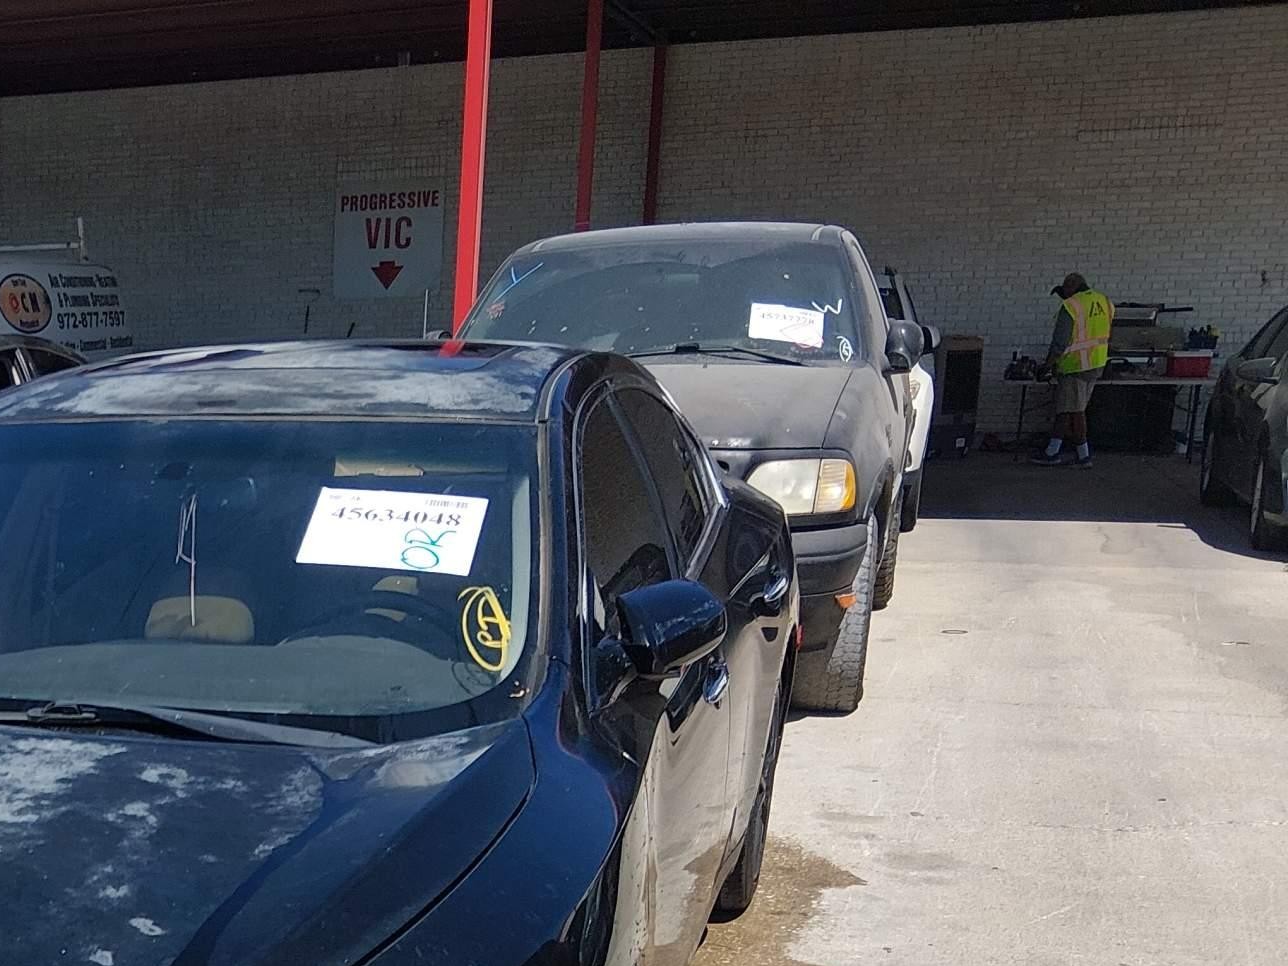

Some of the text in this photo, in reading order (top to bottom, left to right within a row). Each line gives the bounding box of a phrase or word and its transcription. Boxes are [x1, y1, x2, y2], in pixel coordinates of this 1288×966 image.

[341, 190, 440, 213] PROGRESSIVE
[365, 216, 413, 249] VIC
[57, 311, 125, 330] 972-877-7597
[330, 506, 462, 527] 45634048
